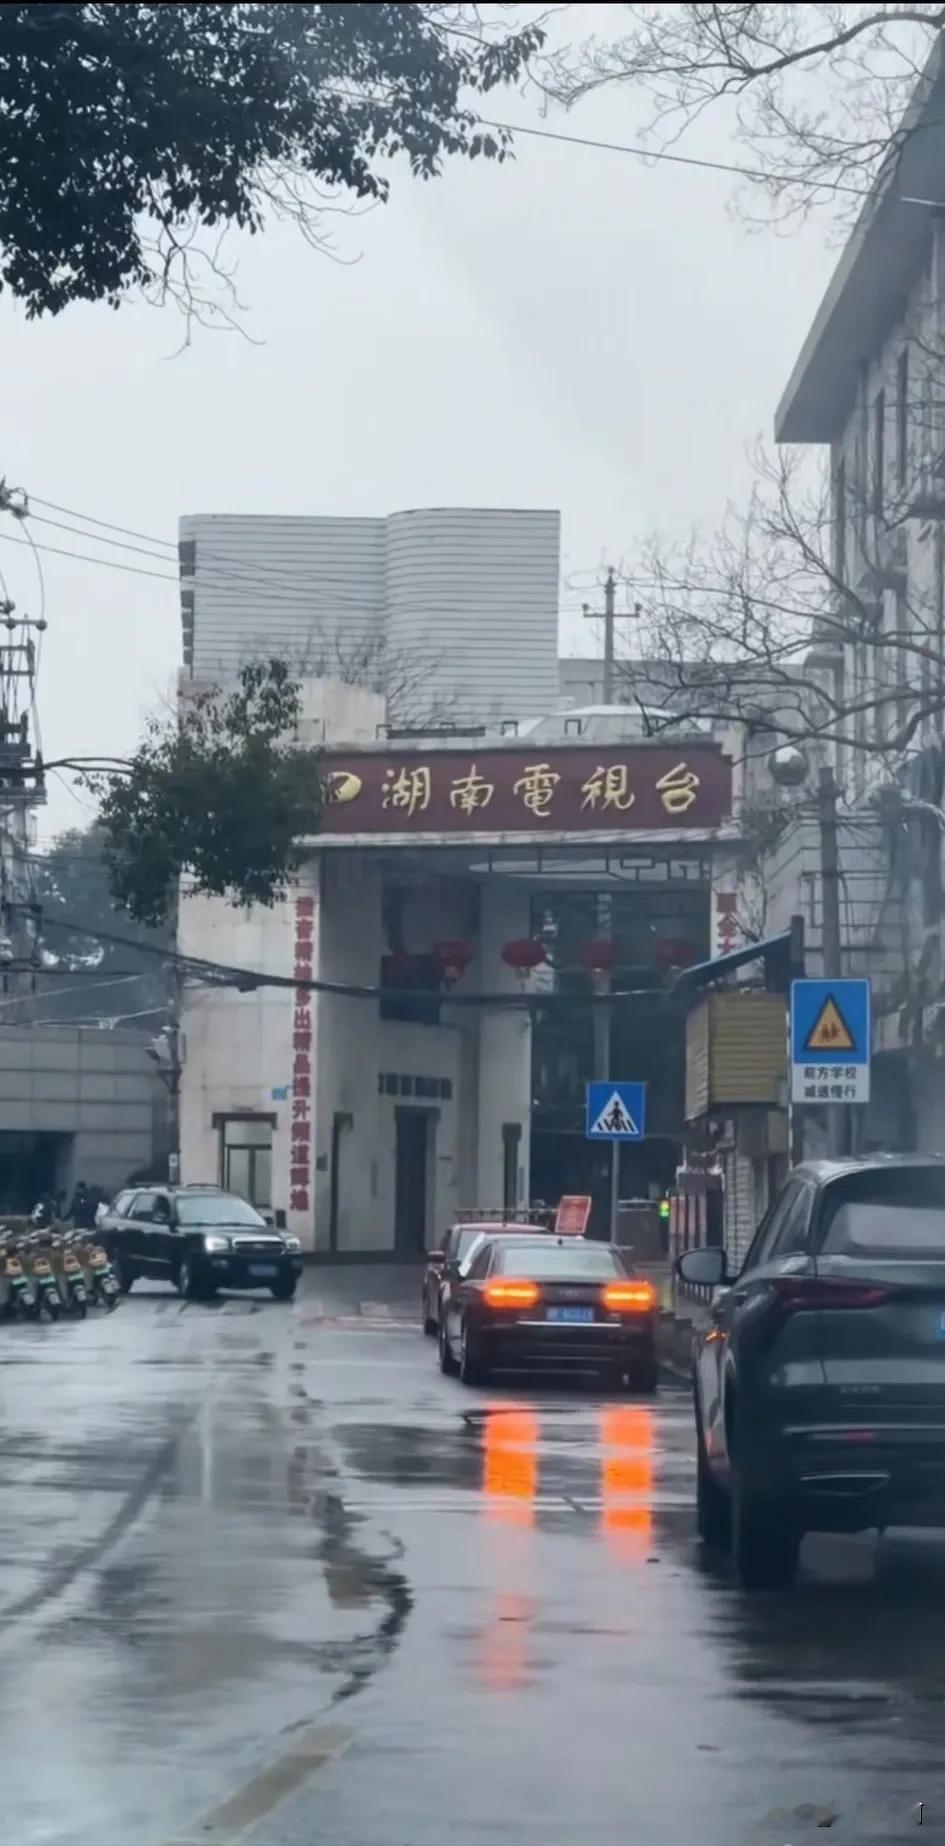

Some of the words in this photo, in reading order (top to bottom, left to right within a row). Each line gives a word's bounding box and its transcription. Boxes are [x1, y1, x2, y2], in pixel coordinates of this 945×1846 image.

[381, 763, 701, 818] 湖南電視台
[803, 1066, 857, 1080] 前方学校
[804, 1084, 857, 1099] 减速慢行
